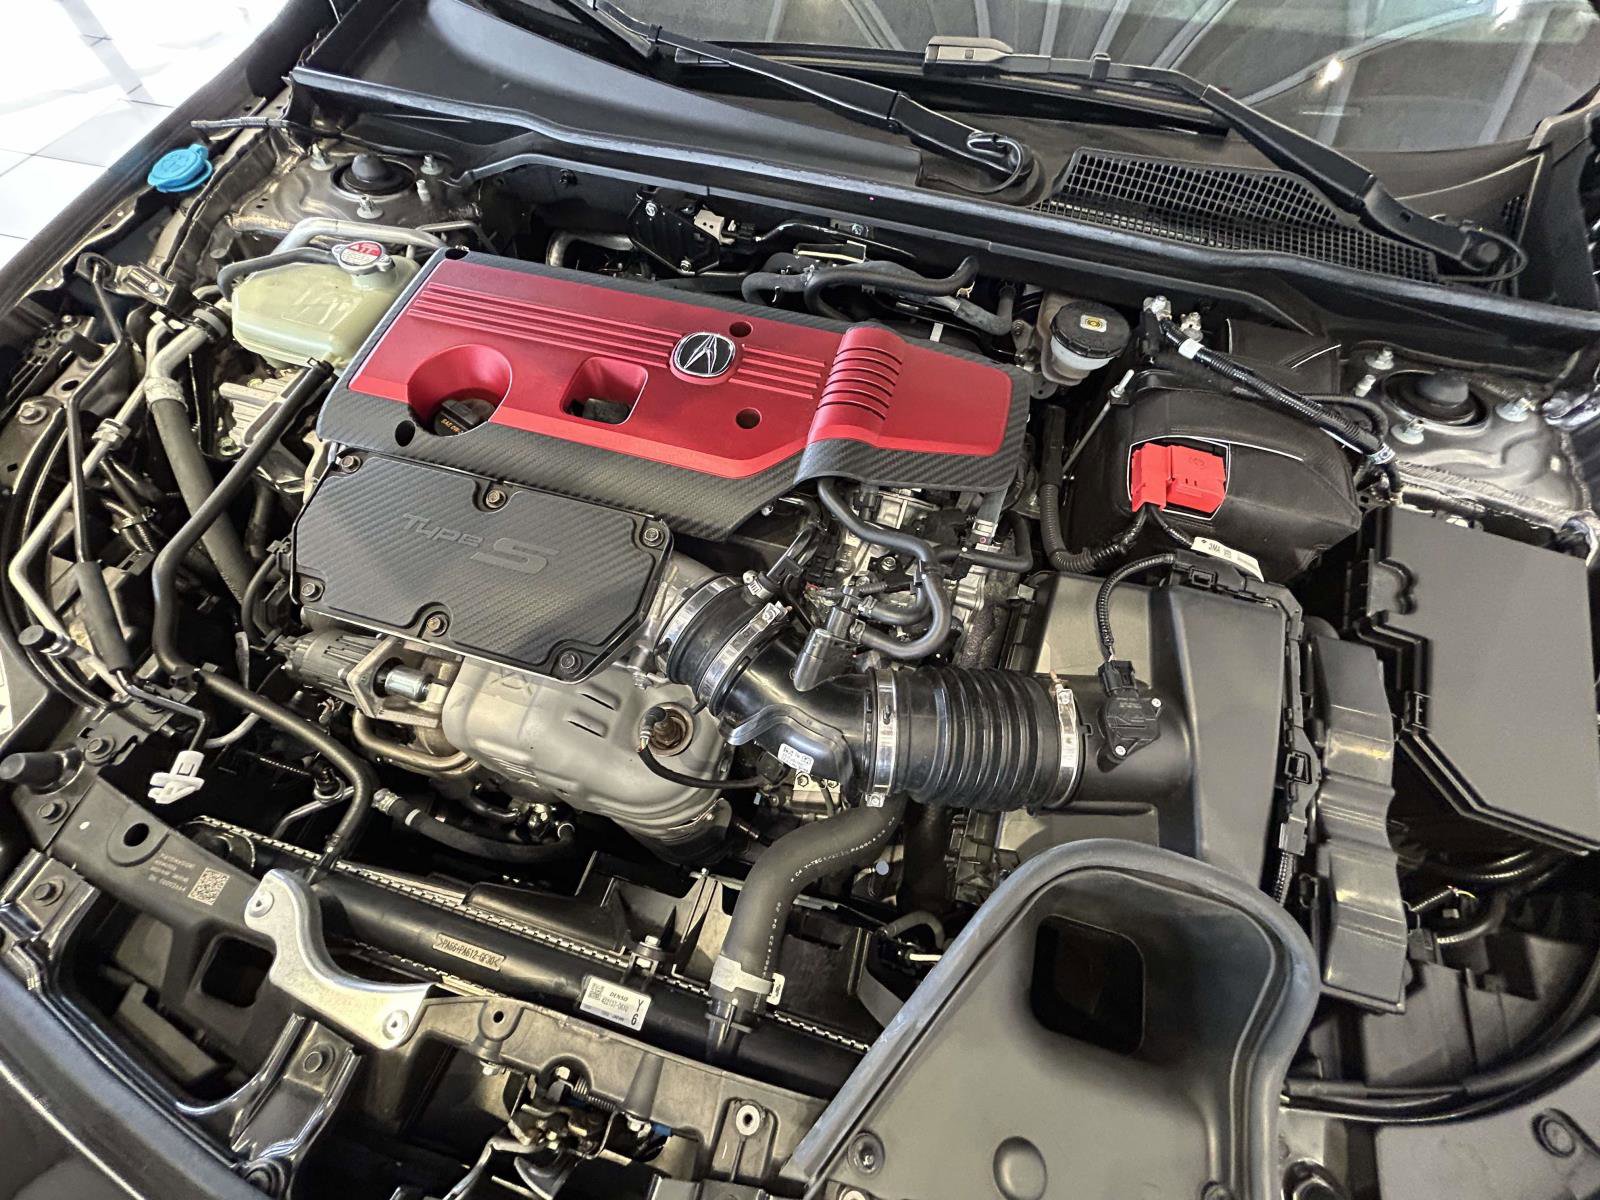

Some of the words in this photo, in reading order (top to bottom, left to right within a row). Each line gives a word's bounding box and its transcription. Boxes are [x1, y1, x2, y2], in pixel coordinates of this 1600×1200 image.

[470, 537, 560, 574] S
[609, 991, 629, 1002] DENSO
[636, 999, 644, 1012] Y
[630, 1013, 639, 1026] 6
